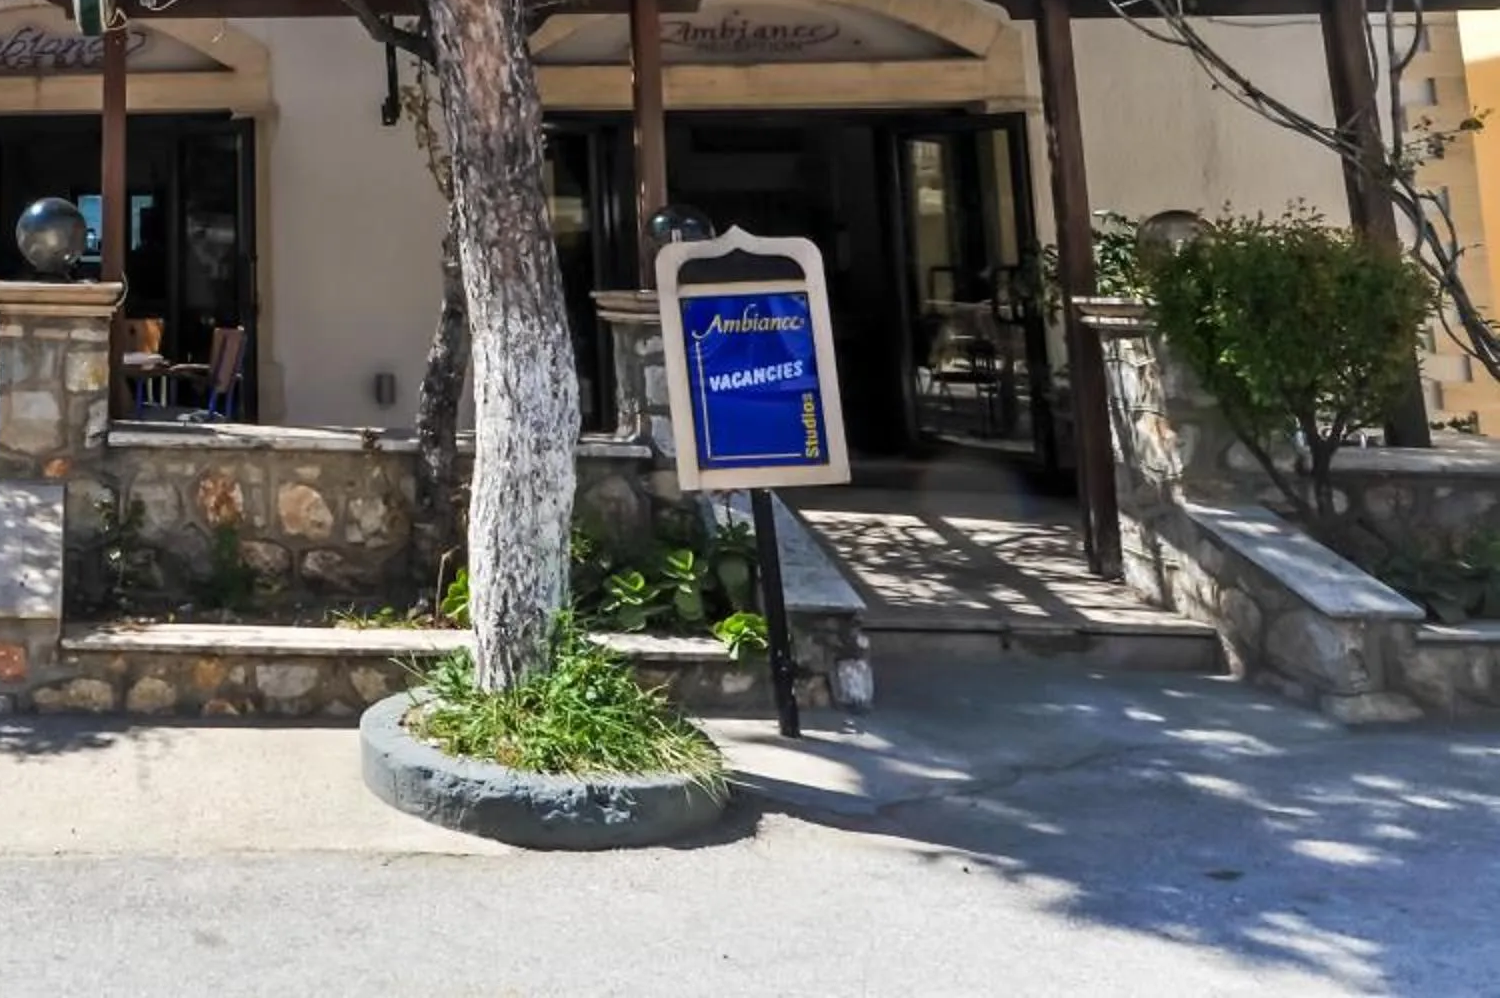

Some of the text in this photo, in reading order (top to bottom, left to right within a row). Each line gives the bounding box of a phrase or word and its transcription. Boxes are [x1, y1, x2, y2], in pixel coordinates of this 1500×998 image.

[691, 303, 805, 339] Ambiance
[709, 360, 804, 392] VACANCIES
[801, 392, 820, 459] Studios
